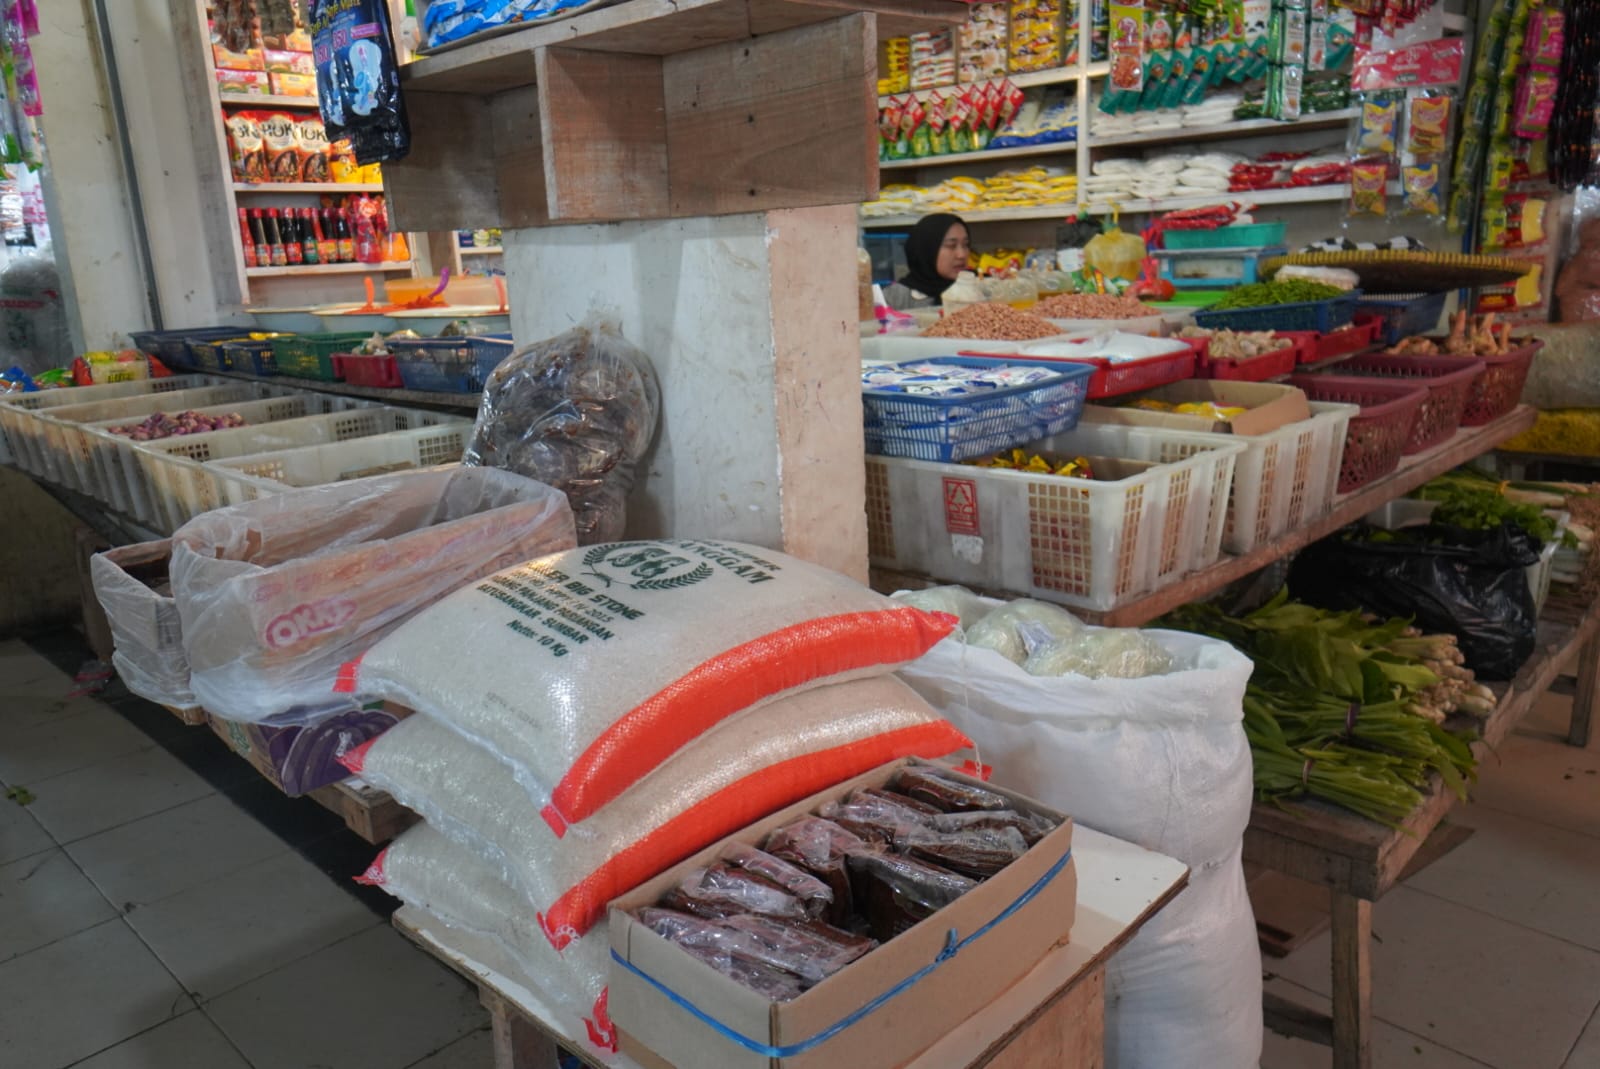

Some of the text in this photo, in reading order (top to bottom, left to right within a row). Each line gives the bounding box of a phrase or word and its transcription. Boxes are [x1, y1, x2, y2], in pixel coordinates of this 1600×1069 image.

[564, 580, 595, 596] BIG
[588, 594, 647, 620] STONE
[541, 617, 590, 644] SUMBAR
[537, 635, 555, 646] 10
[550, 642, 569, 657] Kg
